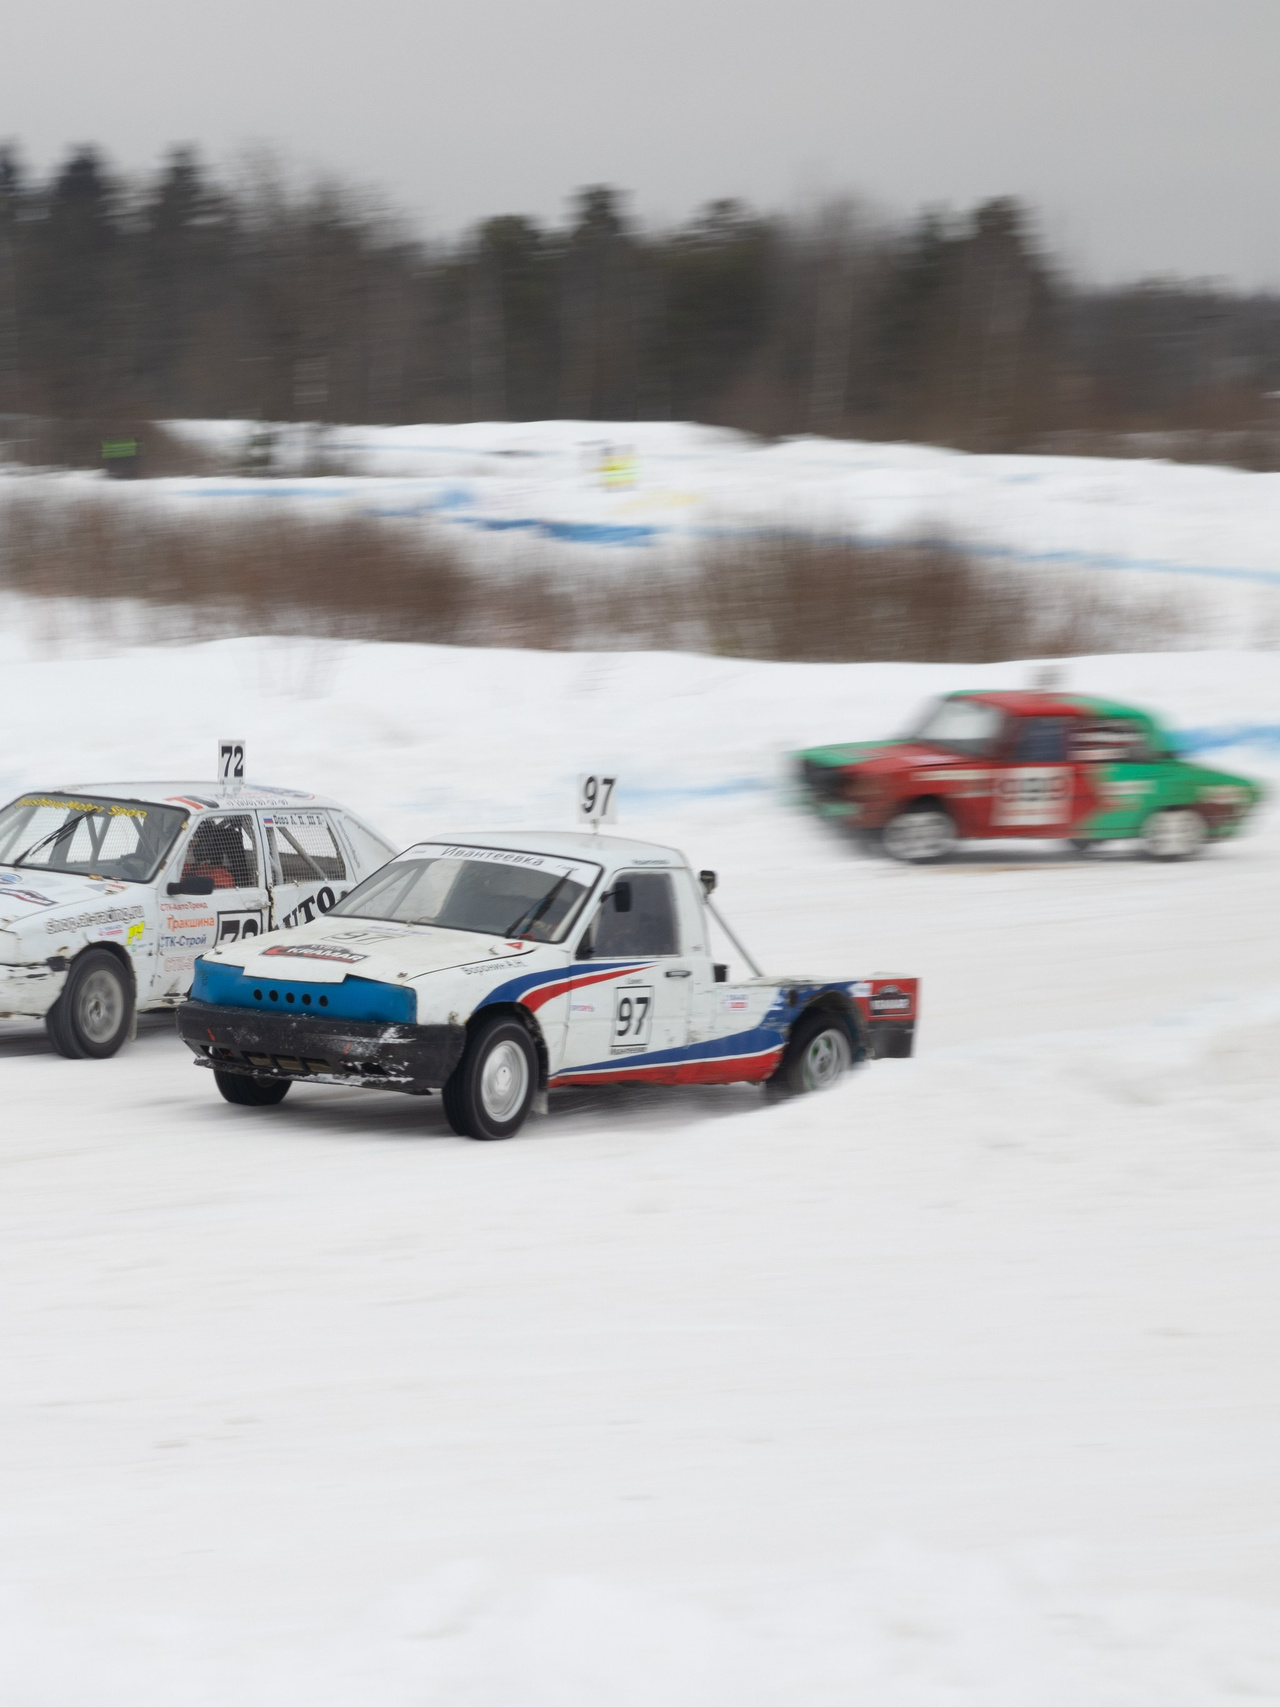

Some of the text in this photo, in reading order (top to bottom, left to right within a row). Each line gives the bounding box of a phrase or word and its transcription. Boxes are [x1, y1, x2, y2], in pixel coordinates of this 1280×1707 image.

[221, 745, 244, 777] 72
[582, 776, 616, 816] 97
[440, 845, 546, 867] Ивантеевка
[166, 916, 215, 932] Тракшина
[286, 947, 364, 962] KRAMAR
[616, 996, 651, 1037] 97
